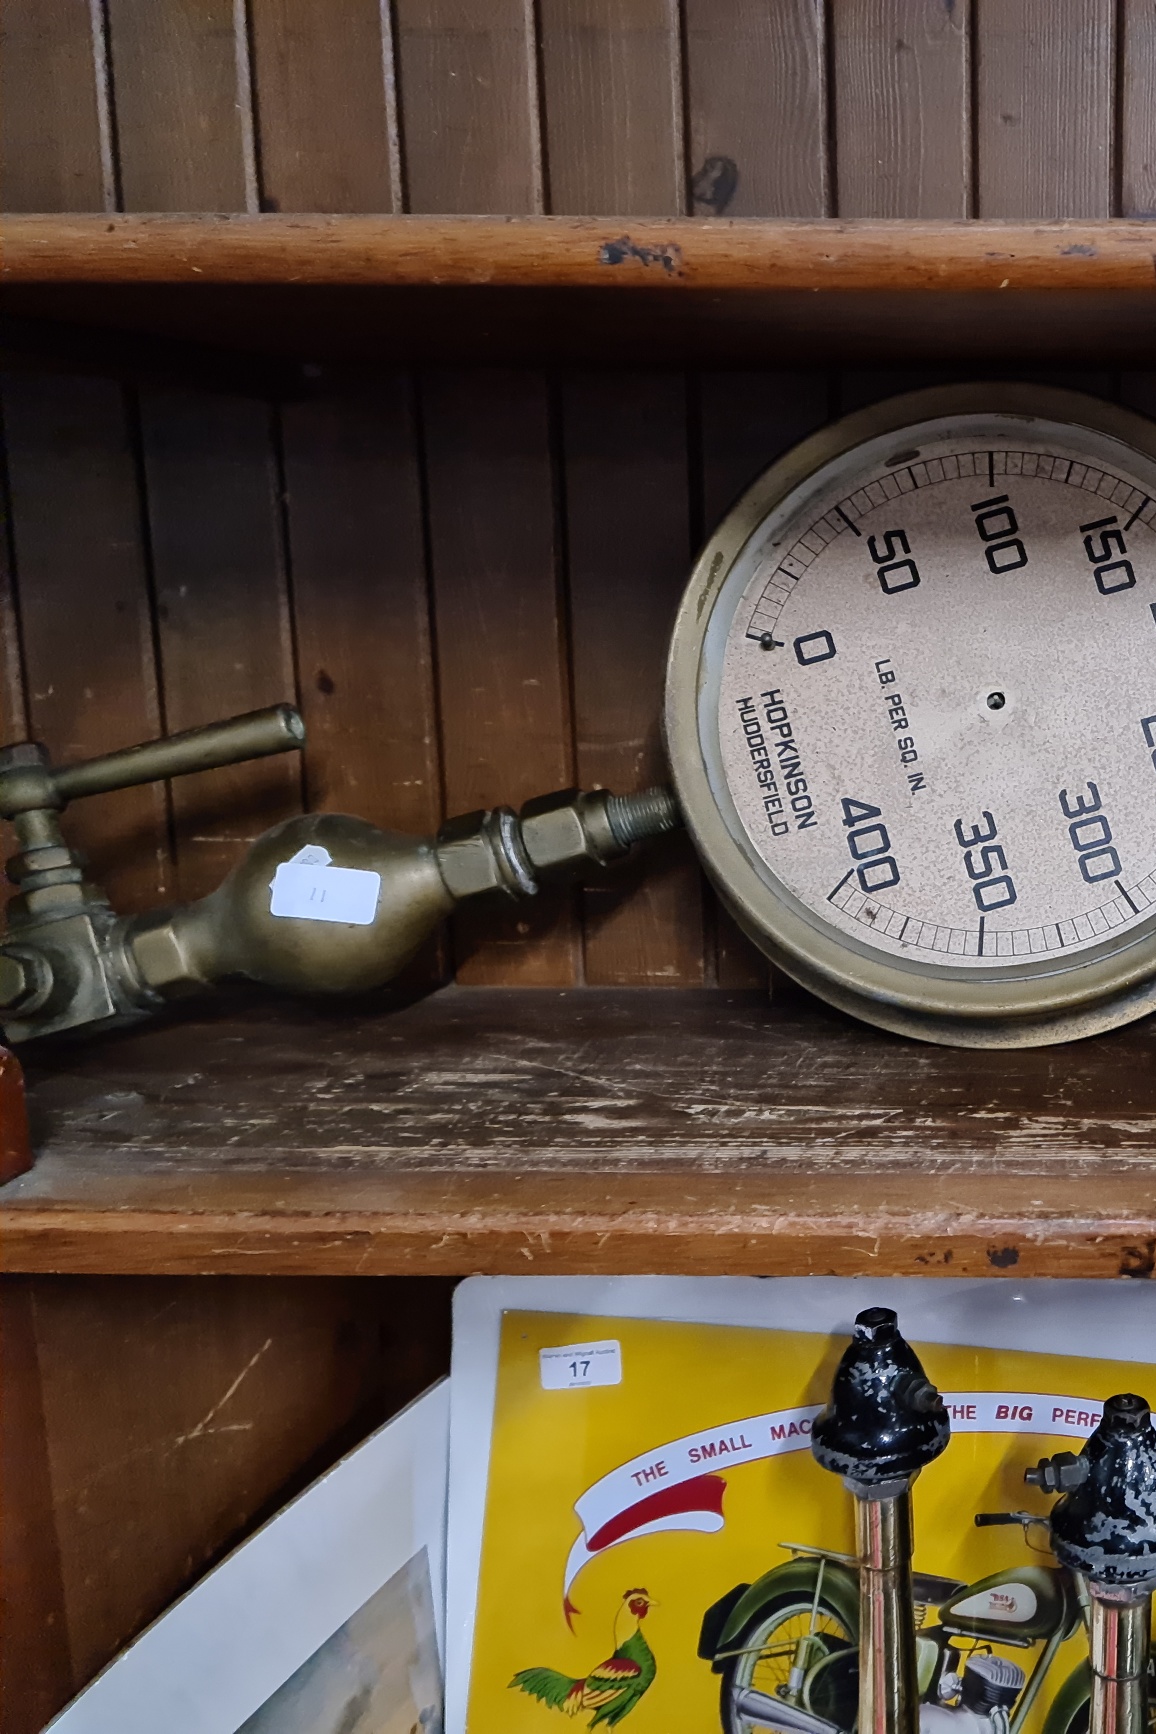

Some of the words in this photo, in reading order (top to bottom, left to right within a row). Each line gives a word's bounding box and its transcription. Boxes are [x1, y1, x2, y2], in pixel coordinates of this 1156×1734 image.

[867, 529, 921, 595] 50
[971, 494, 1028, 574] 100
[1080, 515, 1136, 595] 150
[793, 629, 837, 666] 0
[874, 659, 897, 690] LB.
[884, 693, 909, 732] PER
[897, 736, 919, 768] SQ.
[735, 696, 789, 837] HUDDERSFIELD
[760, 688, 818, 830] HOPKINSON
[907, 771, 927, 796] IN.
[840, 797, 901, 893] 400
[954, 810, 1018, 913] 350
[1058, 782, 1123, 884] 300
[569, 1360, 591, 1377] 17
[631, 1460, 669, 1487] THE
[688, 1434, 752, 1464] SMALL
[770, 1419, 811, 1441] MAC
[996, 1405, 1033, 1421] BIG
